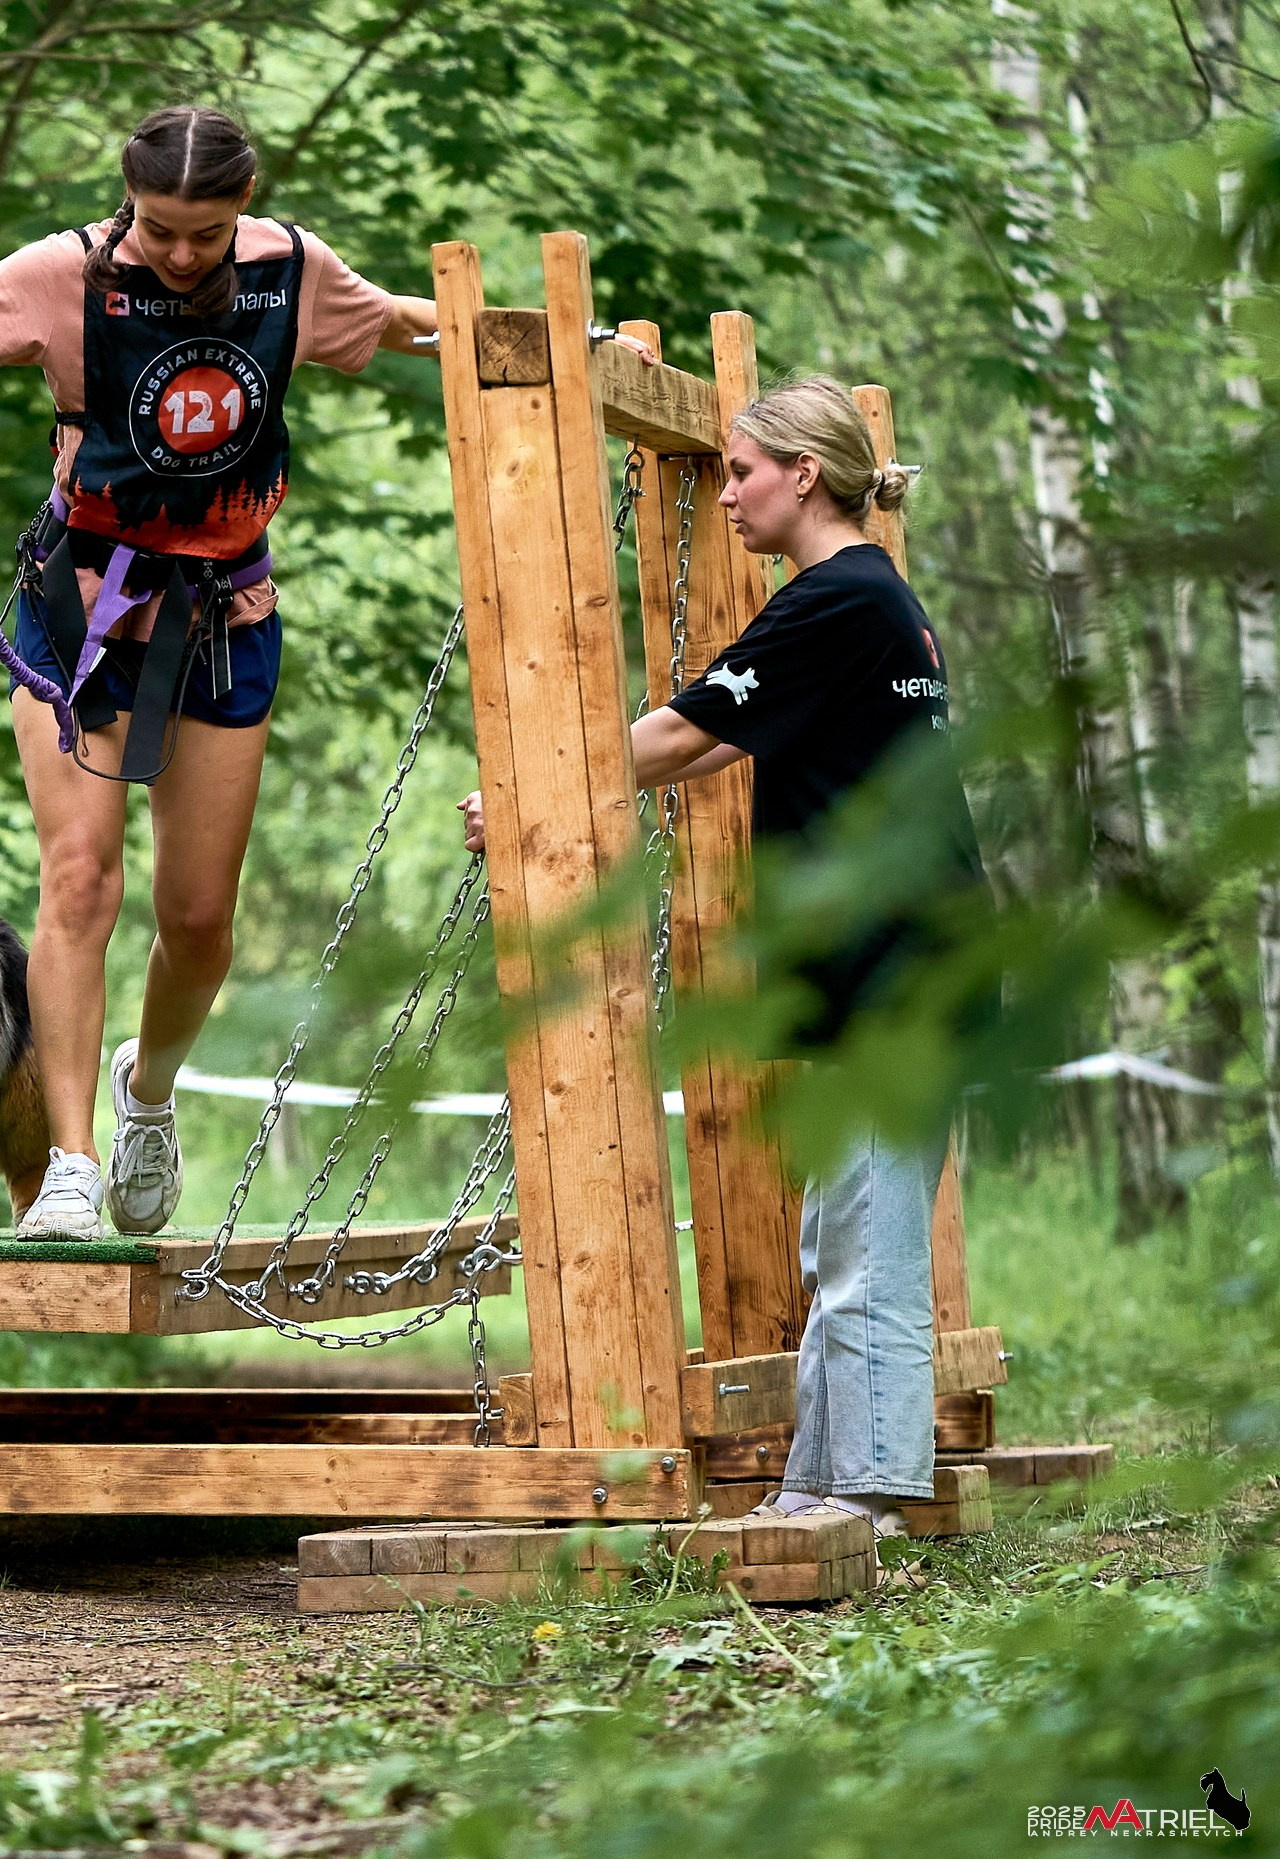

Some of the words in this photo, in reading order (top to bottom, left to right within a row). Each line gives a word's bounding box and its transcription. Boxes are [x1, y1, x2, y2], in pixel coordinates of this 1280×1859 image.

[138, 348, 198, 416] RUSSIAN
[205, 348, 261, 411] EXTREME
[164, 388, 241, 434] 121
[150, 446, 181, 468] DOG
[188, 443, 242, 468] TRAIL
